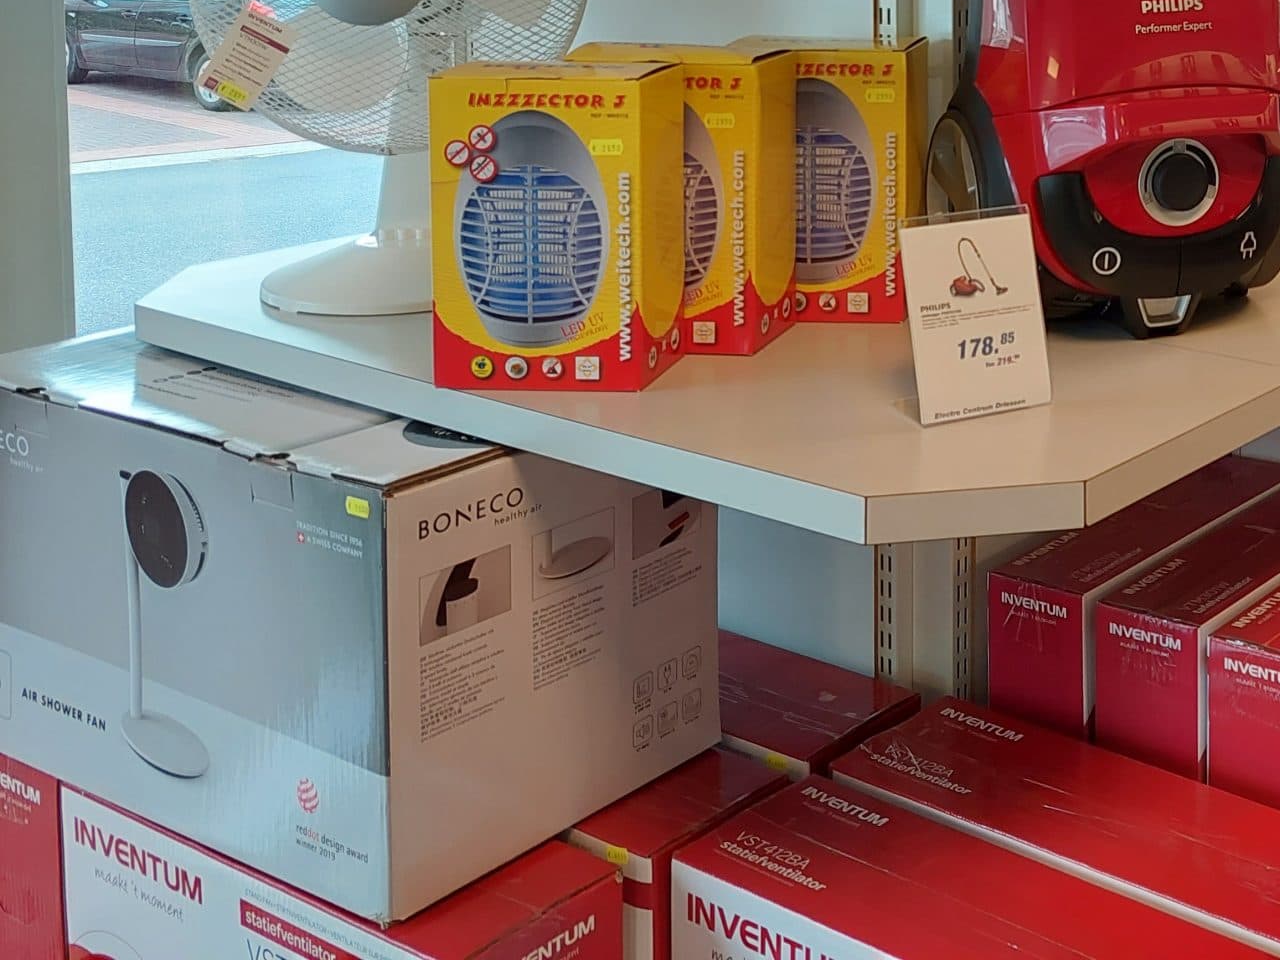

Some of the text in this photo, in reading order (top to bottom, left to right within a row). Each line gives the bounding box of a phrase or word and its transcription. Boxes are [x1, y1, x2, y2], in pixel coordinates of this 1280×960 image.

[1135, 22, 1213, 35] Performer Expert
[468, 93, 627, 109] INZZZECTOR J
[883, 132, 897, 296] www.weitech.com
[731, 150, 745, 327] www.weitech.com
[615, 172, 632, 361] www.weitech.com
[920, 302, 951, 313] PHILIPS
[561, 320, 586, 337] LED
[417, 487, 524, 540] BONECO
[494, 502, 543, 527] healthy air
[1012, 531, 1079, 567] INVENTUM
[1122, 558, 1187, 595] INVENTUM
[1001, 592, 1067, 619] INVENTUM
[1109, 622, 1182, 651] INVENTUM
[22, 687, 107, 732] AIR SHOWER FAN
[940, 706, 1025, 742] INVENTUM
[870, 753, 972, 794] statiefventilator
[801, 785, 890, 828] INVENTUM
[74, 815, 203, 906] INVENTUM
[319, 847, 336, 861] 2019
[320, 834, 345, 853] design
[346, 847, 369, 864] award
[719, 839, 827, 892] statiefventilator
[139, 889, 186, 922] moment
[245, 910, 337, 960] statiefventilator
